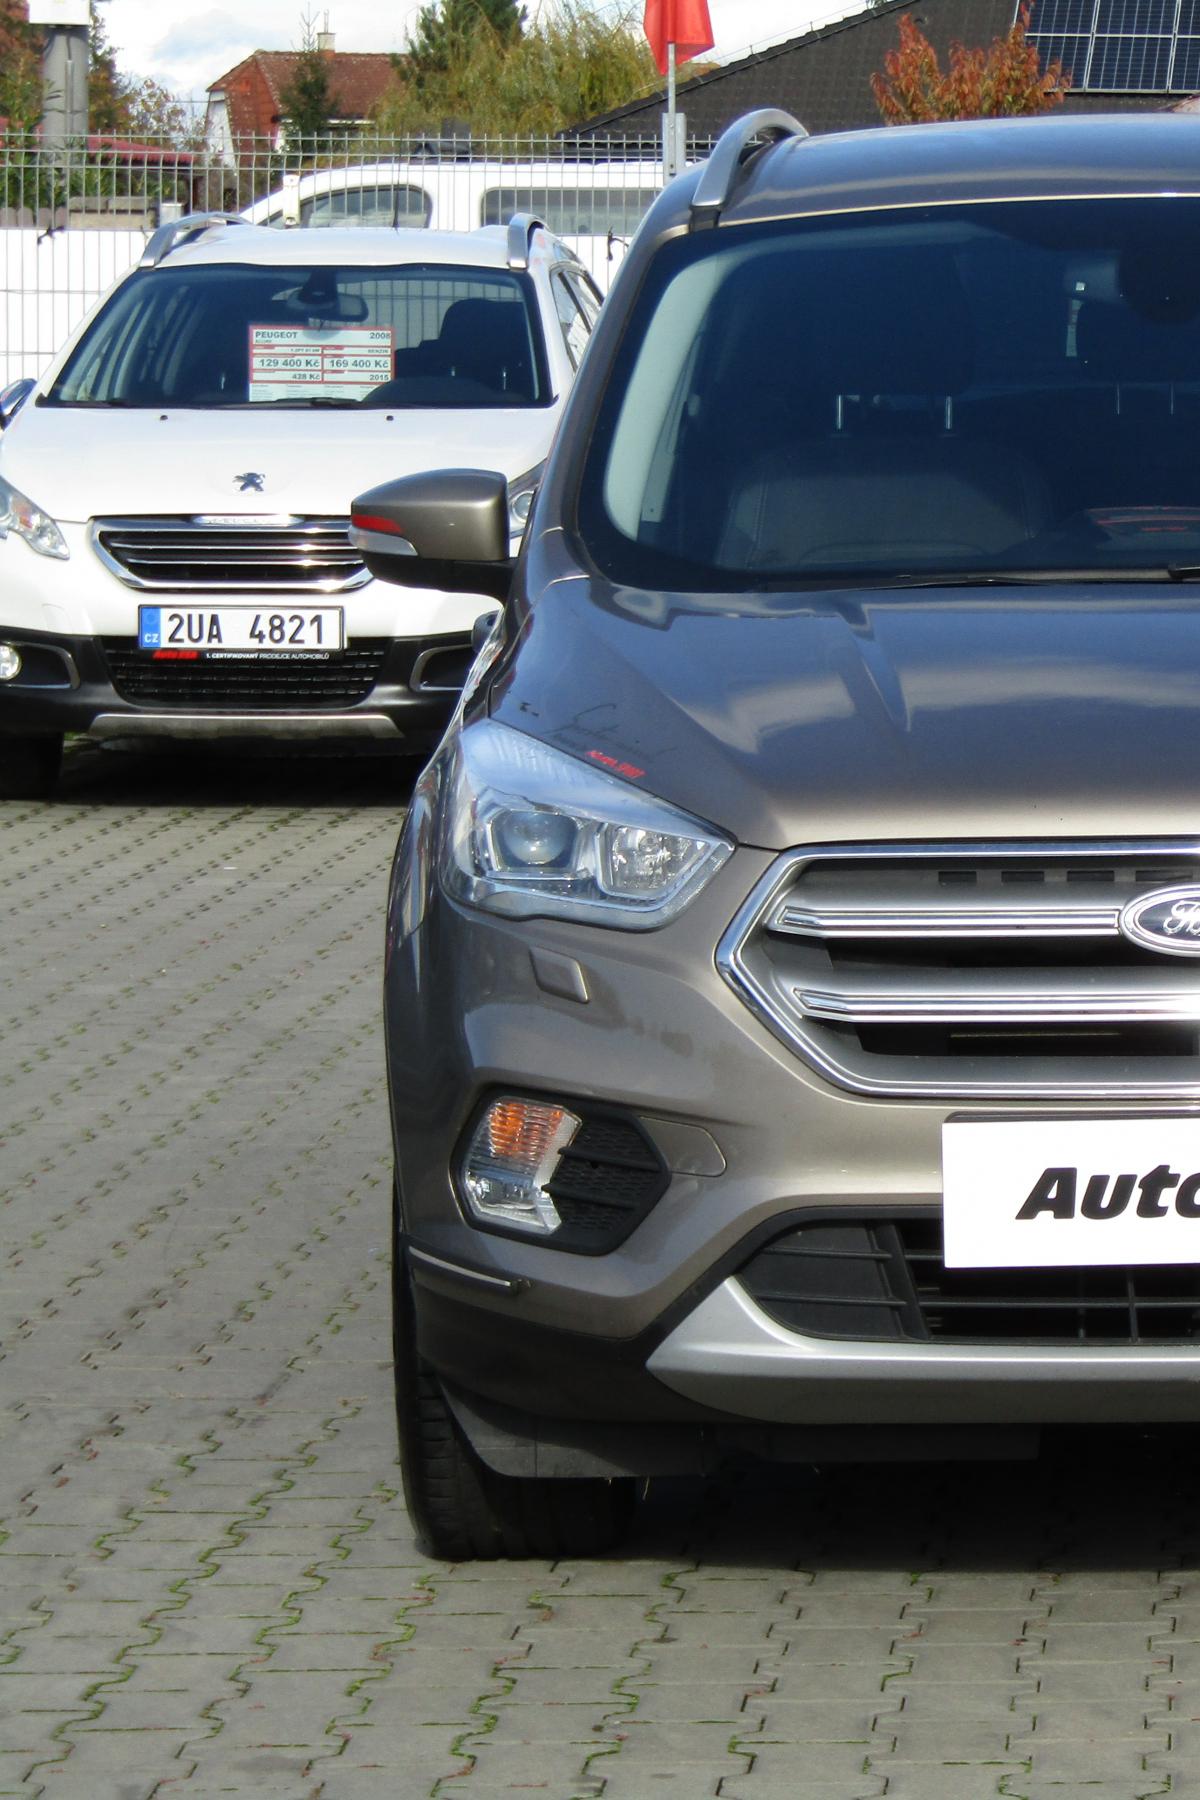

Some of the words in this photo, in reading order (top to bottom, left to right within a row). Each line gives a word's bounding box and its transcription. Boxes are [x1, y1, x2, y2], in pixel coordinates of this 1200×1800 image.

[255, 331, 298, 339] PEUGEOT
[369, 332, 391, 340] 2008
[260, 359, 279, 368] 129
[282, 359, 302, 368] 400
[305, 359, 320, 368] Kč
[330, 359, 349, 368] 169
[352, 359, 371, 368] 400
[374, 359, 389, 368] Kč
[167, 613, 224, 645] 2UA
[249, 614, 323, 645] 4821
[144, 632, 159, 643] CZ
[212, 652, 259, 660] CERTIFIKOVANÝ
[259, 652, 290, 660] PRODEJCE
